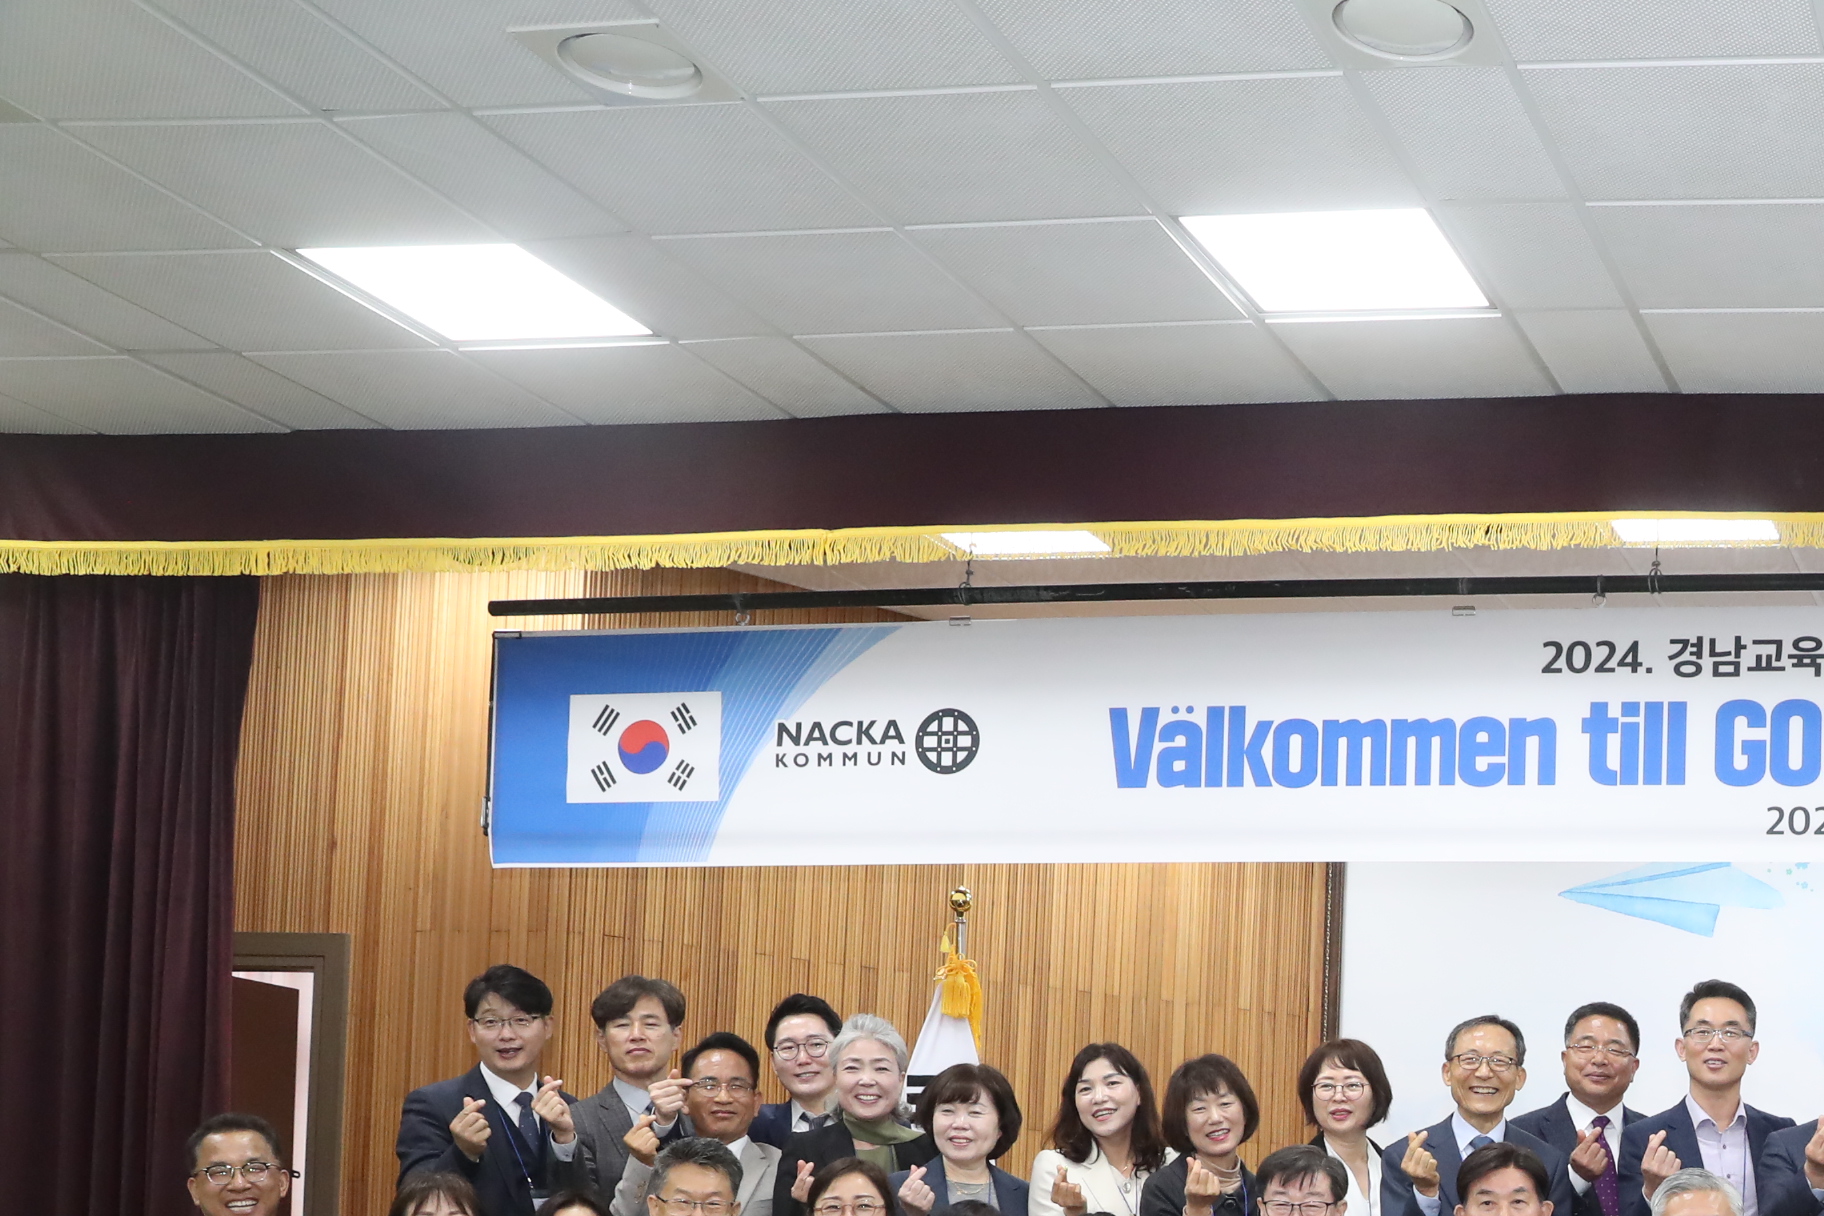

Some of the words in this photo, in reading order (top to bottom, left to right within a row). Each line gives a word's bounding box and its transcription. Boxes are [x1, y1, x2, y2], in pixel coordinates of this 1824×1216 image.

[1541, 639, 1653, 674] 2024.
[775, 719, 906, 748] NACKA
[1108, 704, 1558, 789] Välkommen
[1581, 700, 1688, 788] till
[775, 750, 906, 769] KOMMUN
